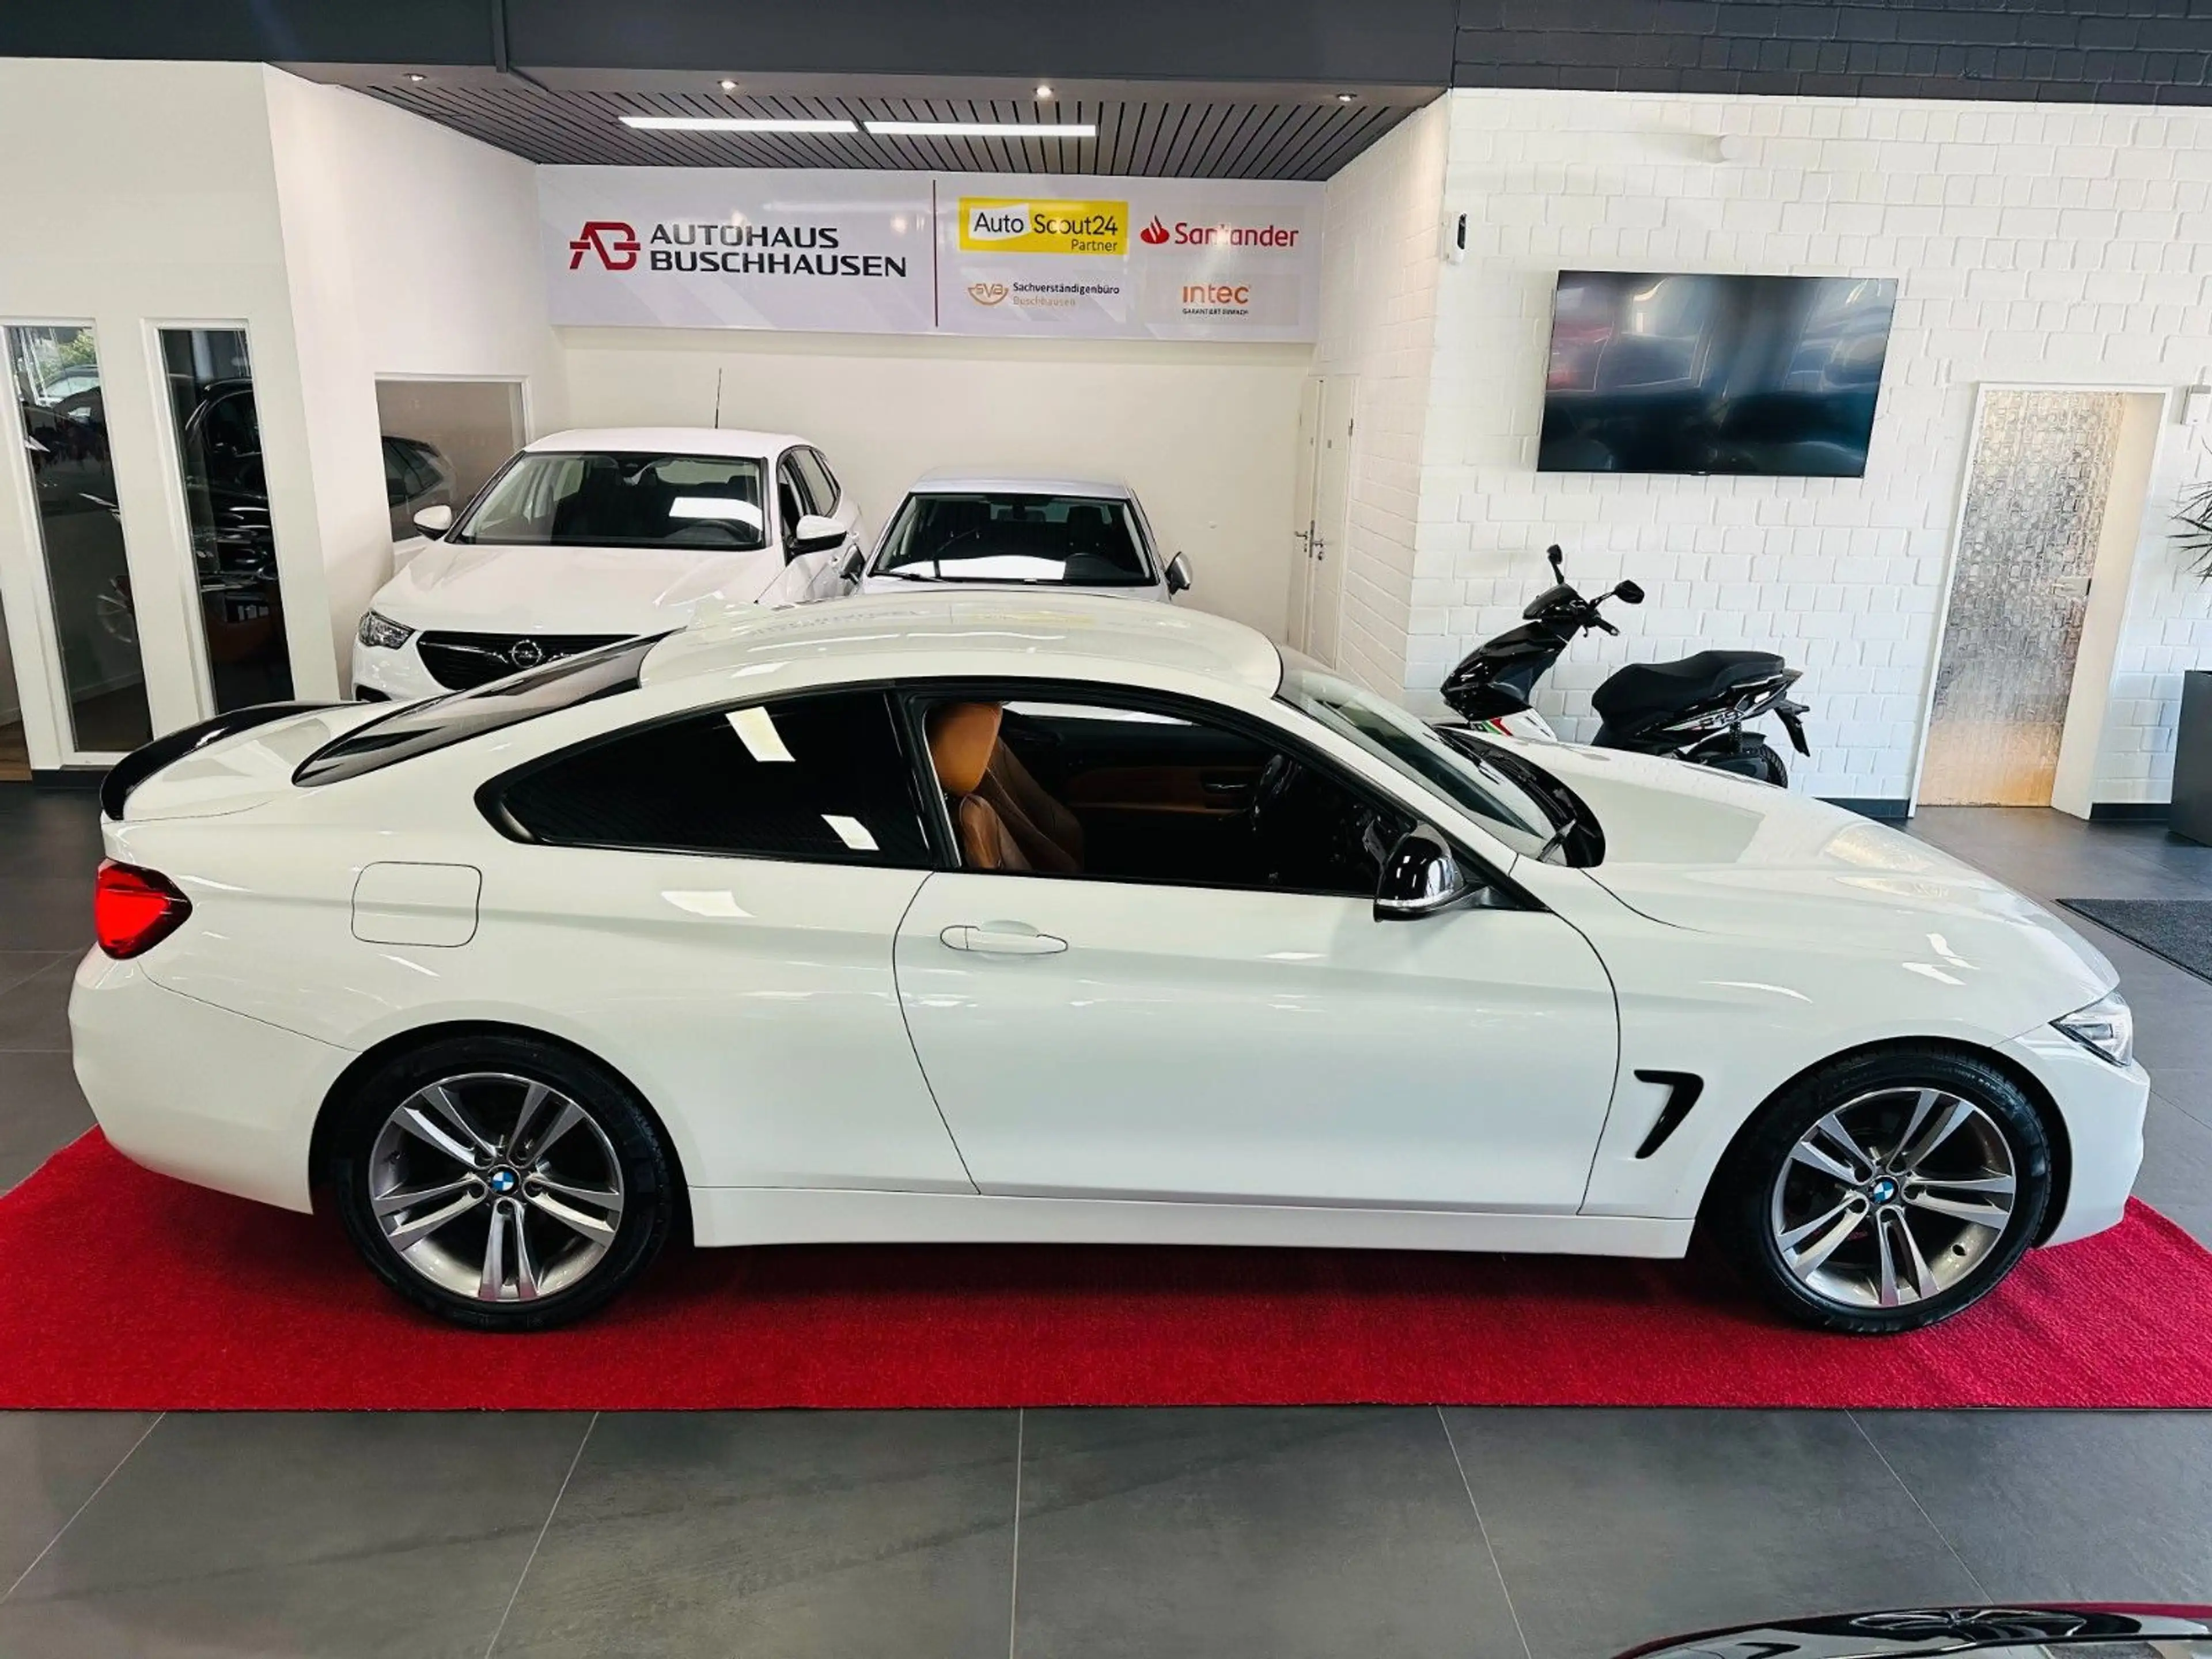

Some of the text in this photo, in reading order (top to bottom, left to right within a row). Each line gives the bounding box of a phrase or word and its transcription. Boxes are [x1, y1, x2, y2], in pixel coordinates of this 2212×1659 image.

[974, 213, 1118, 236] Auto Scout24
[1175, 222, 1299, 246] Sanander
[650, 224, 839, 249] AUTOHAUS
[1071, 240, 1118, 252] Partner
[650, 251, 906, 278] BUSCHHAUSEN
[1013, 282, 1120, 295] Sachverständigenbüro
